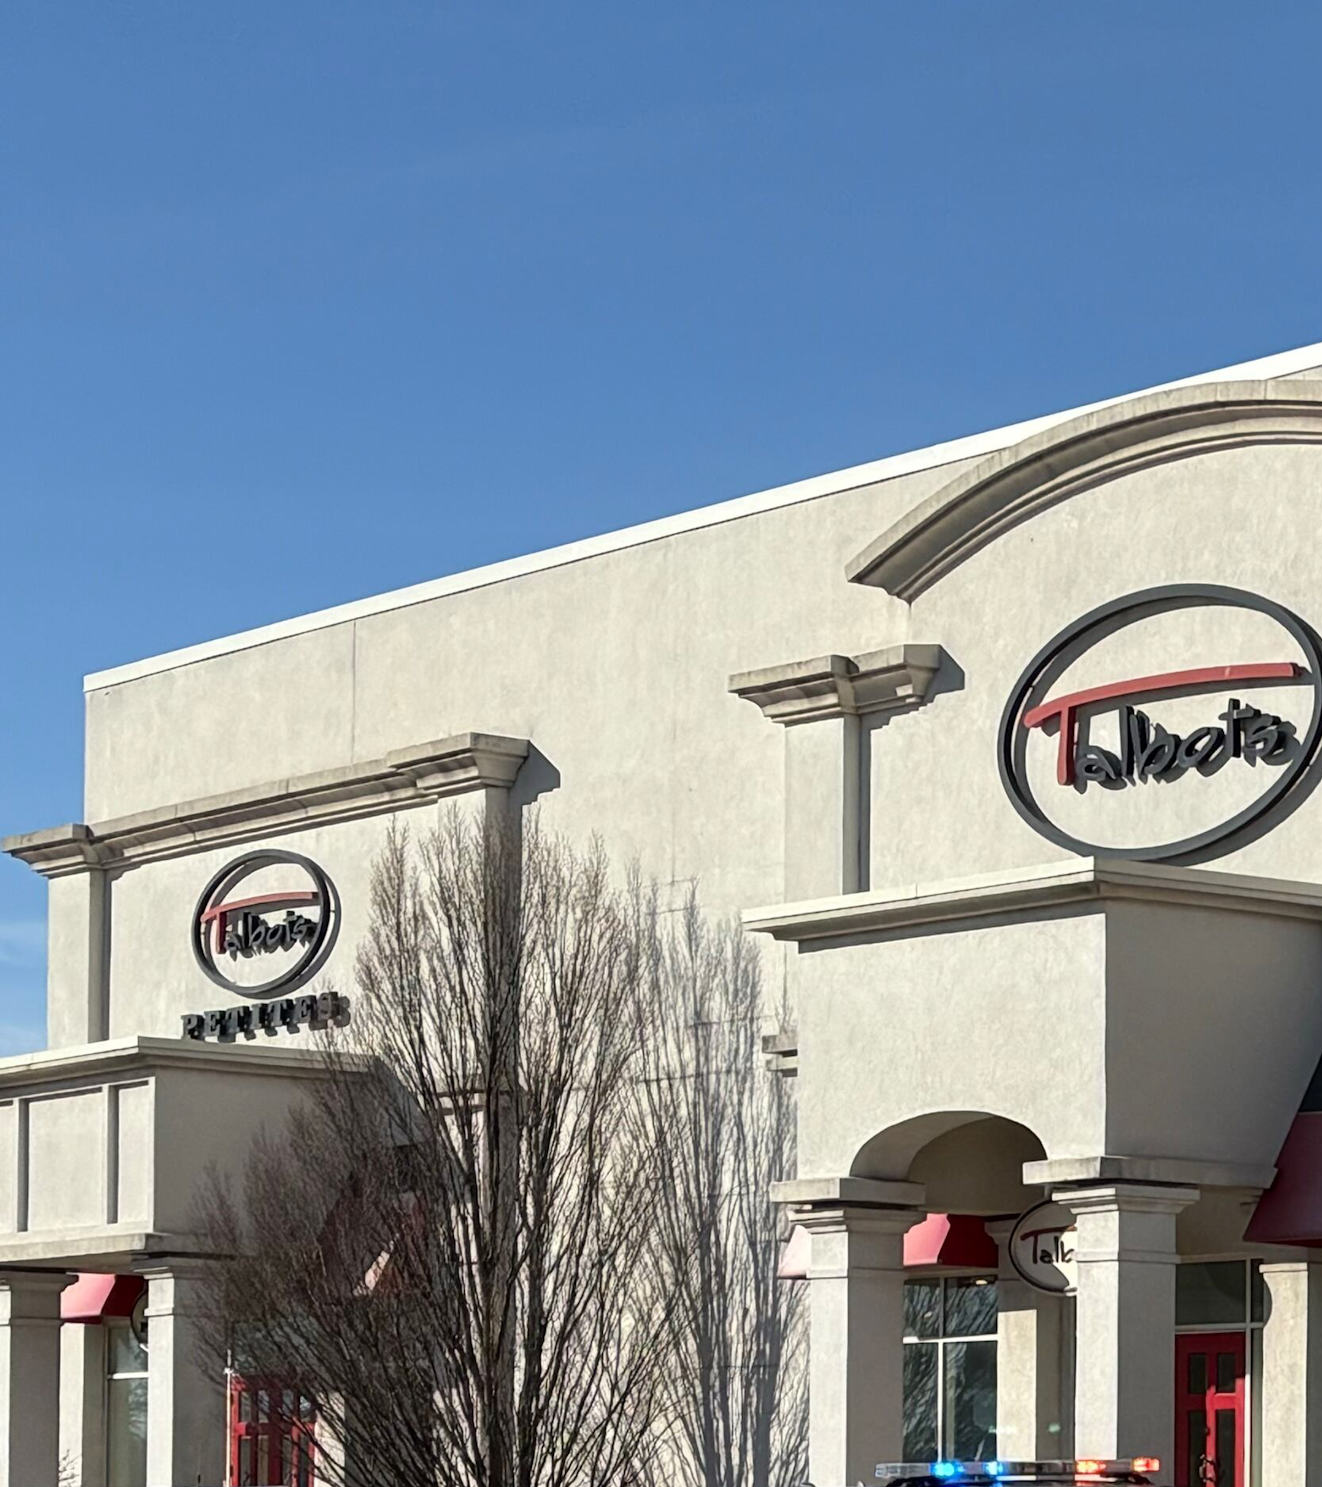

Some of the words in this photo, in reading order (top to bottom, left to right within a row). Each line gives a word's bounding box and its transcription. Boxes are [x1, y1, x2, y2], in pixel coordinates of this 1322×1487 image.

[1023, 662, 1297, 787] Talbots
[200, 891, 317, 955] Talbots
[180, 991, 339, 1040] PETITES
[1020, 1224, 1077, 1264] Talb
